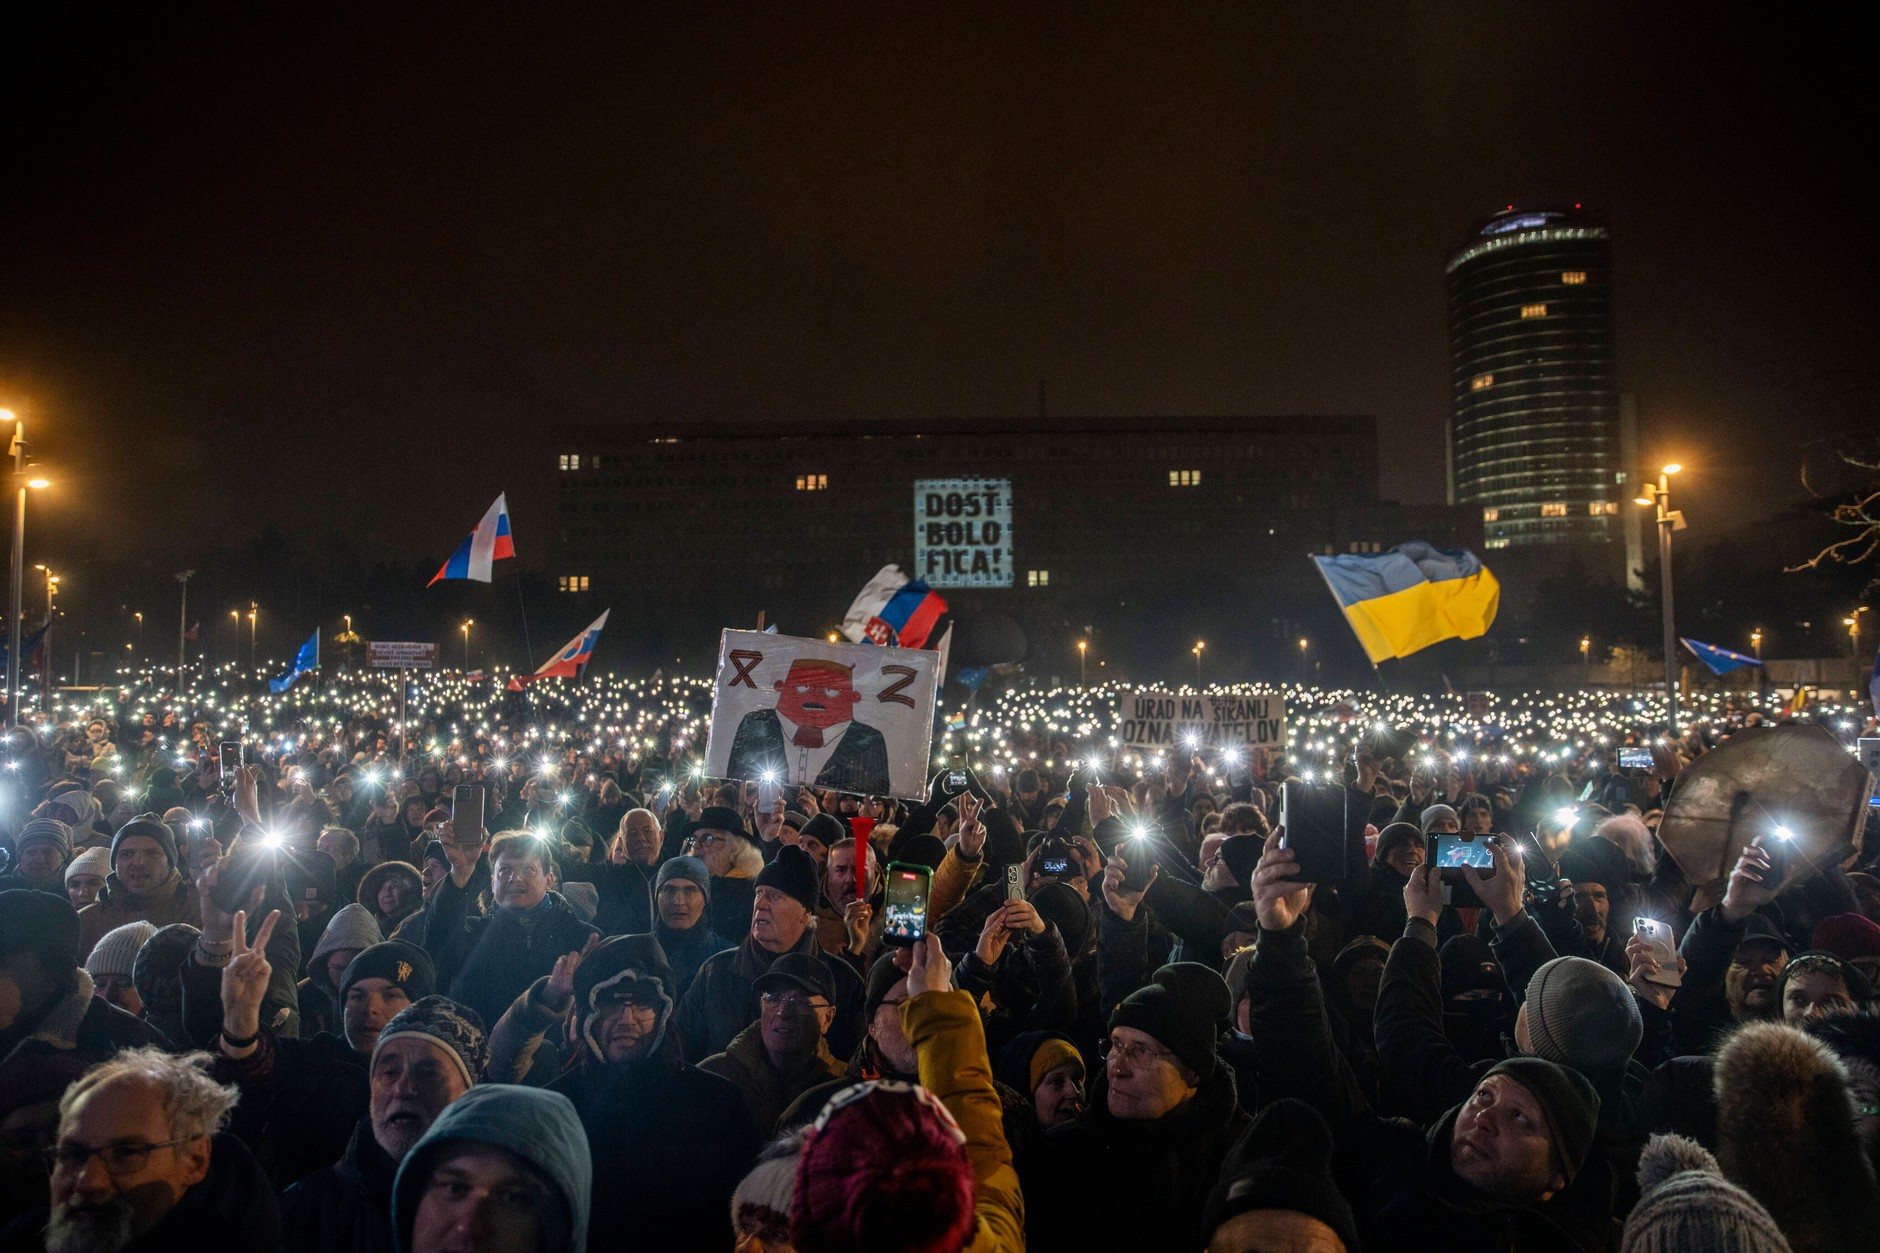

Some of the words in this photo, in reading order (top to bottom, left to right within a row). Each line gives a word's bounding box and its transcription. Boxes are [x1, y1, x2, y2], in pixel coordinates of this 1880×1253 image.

[926, 484, 1000, 517] DOSŤ
[926, 521, 1001, 546] BOLO
[926, 548, 1002, 575] FICA!
[1135, 696, 1175, 720] ÚRAD
[1181, 699, 1204, 720] NA
